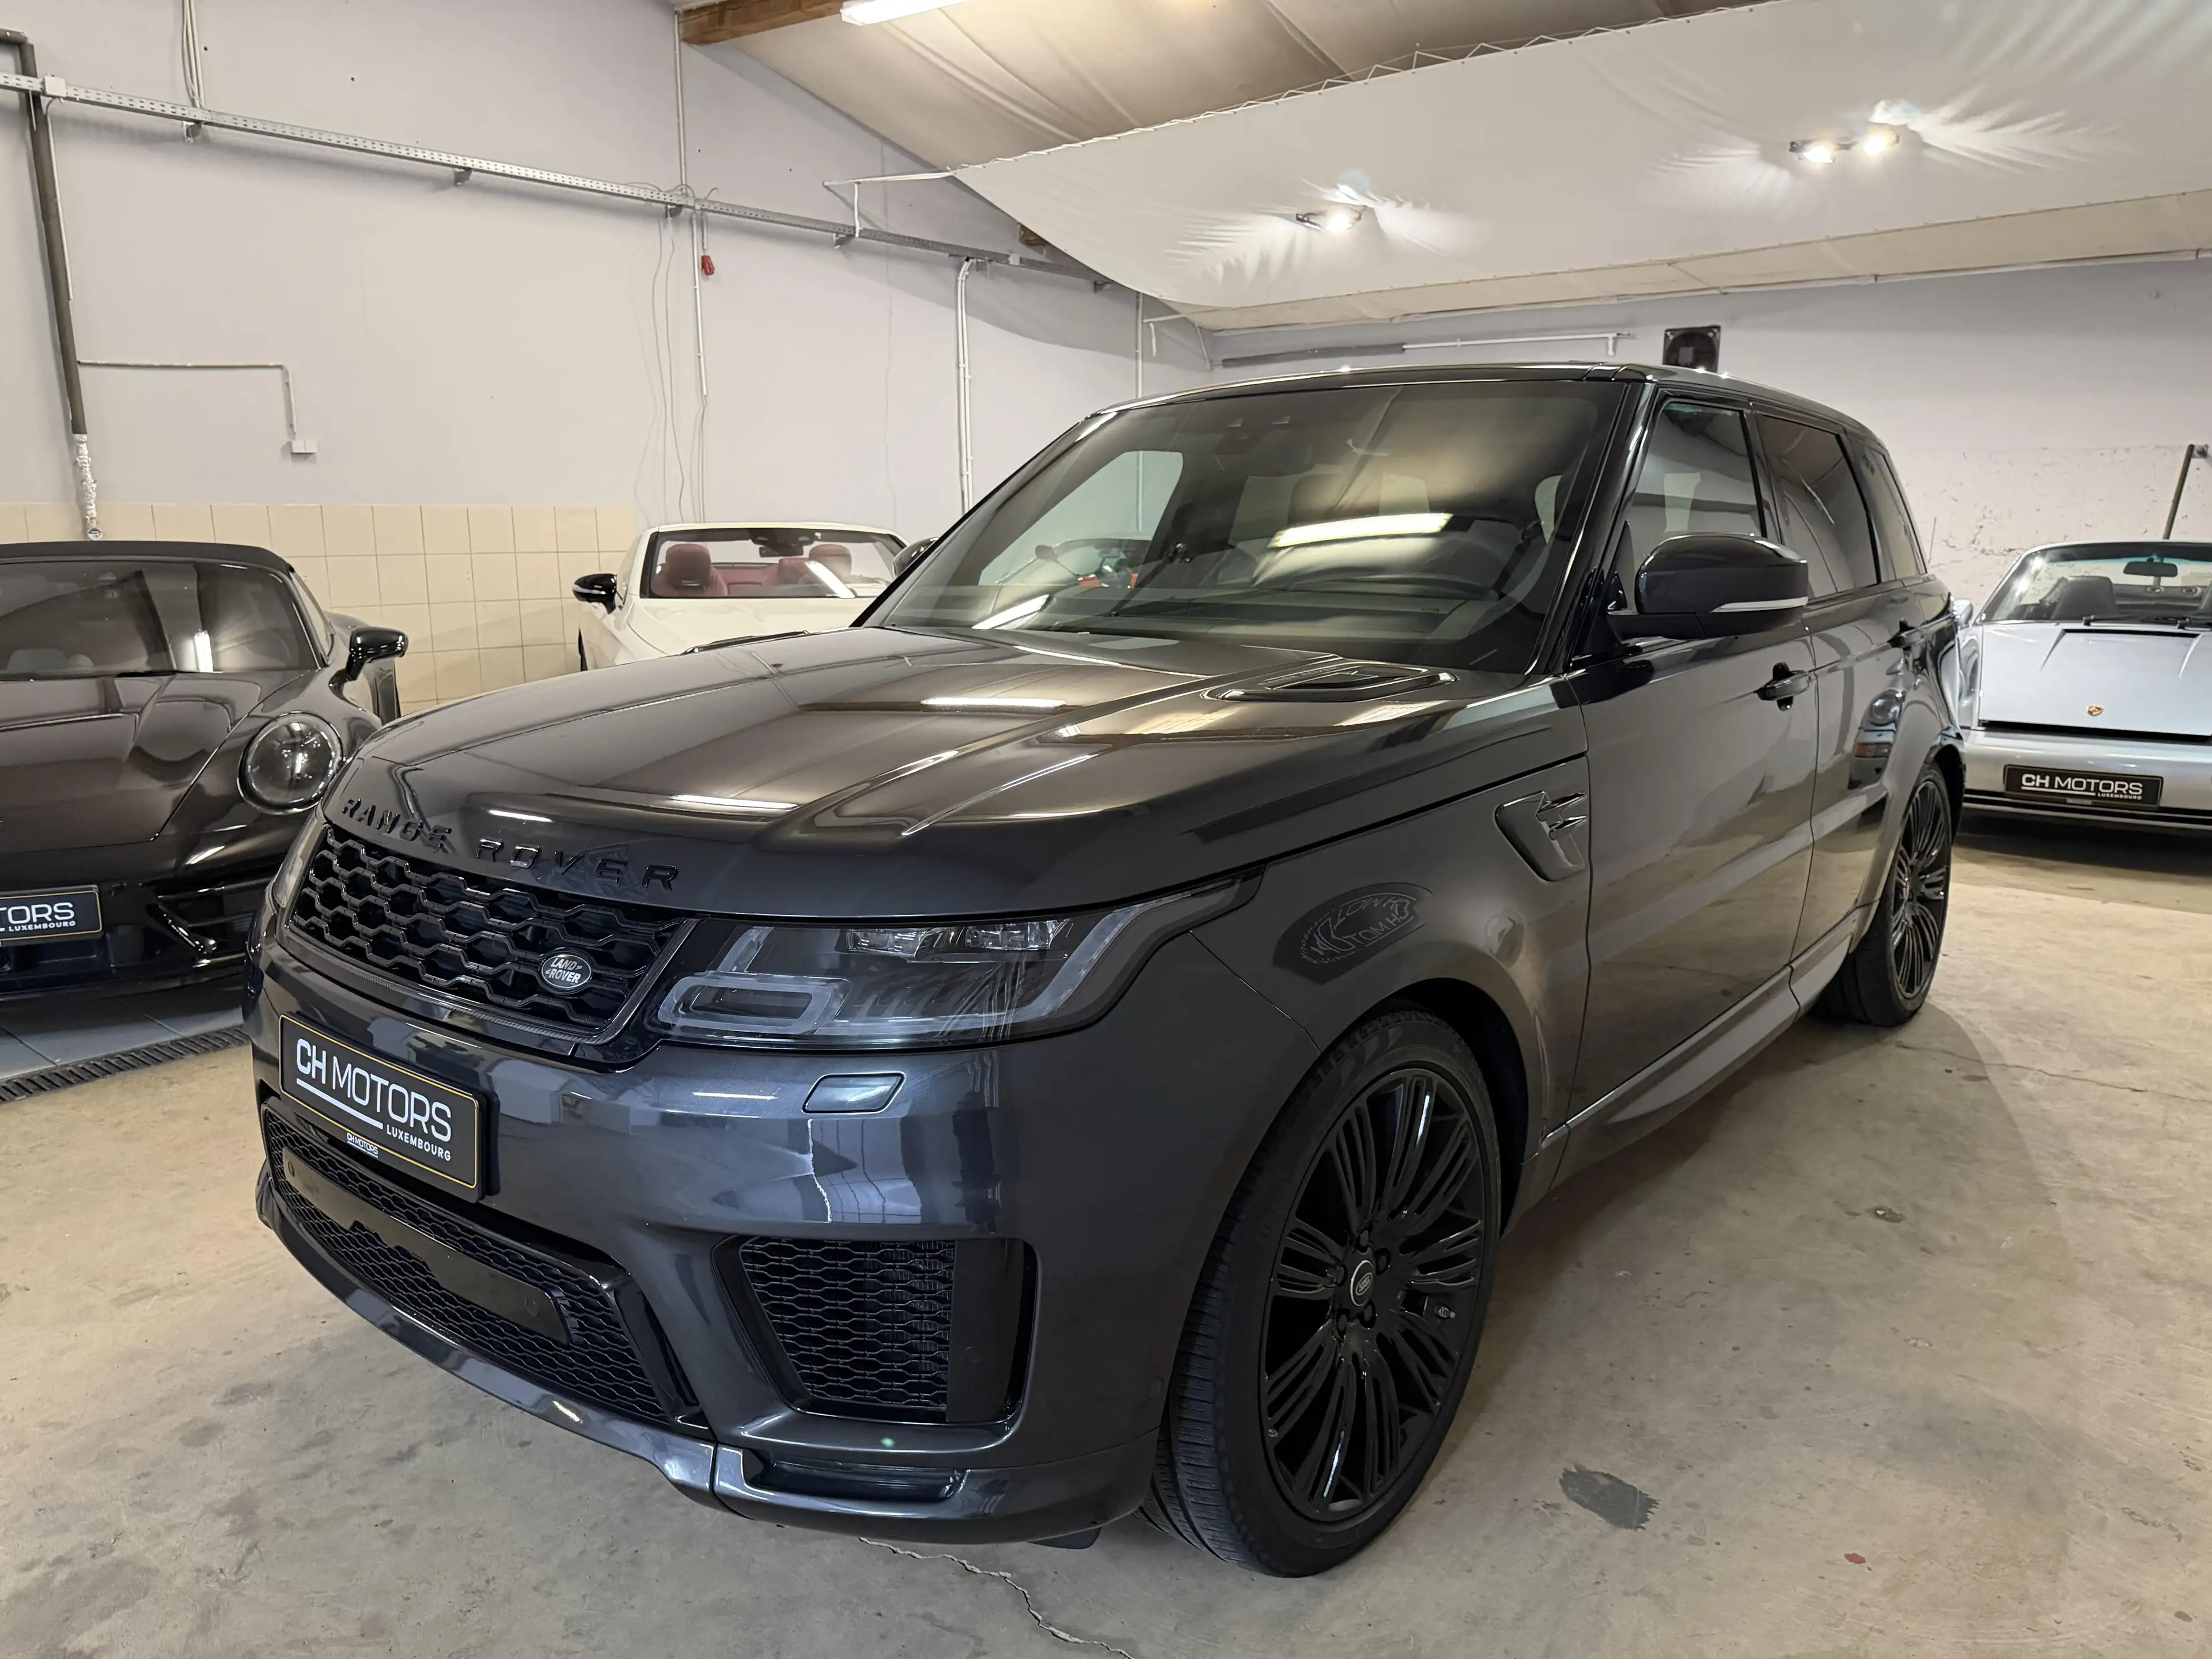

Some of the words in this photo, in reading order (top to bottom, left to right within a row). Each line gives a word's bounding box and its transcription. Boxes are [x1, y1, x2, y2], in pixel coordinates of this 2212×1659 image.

[2021, 774, 2050, 787] CH
[2054, 776, 2143, 795] MOTORS
[342, 797, 453, 851] RANGE
[476, 838, 679, 891] ROVER
[8, 921, 77, 932] LUXEMBOURG
[551, 957, 578, 971] LAND
[548, 968, 581, 984] ROVER
[297, 1038, 327, 1085] CH
[332, 1055, 452, 1142] MOTORS
[347, 1132, 355, 1143] CH
[355, 1136, 378, 1155] MOTORS
[387, 1124, 451, 1161] LUXEMBOURG
